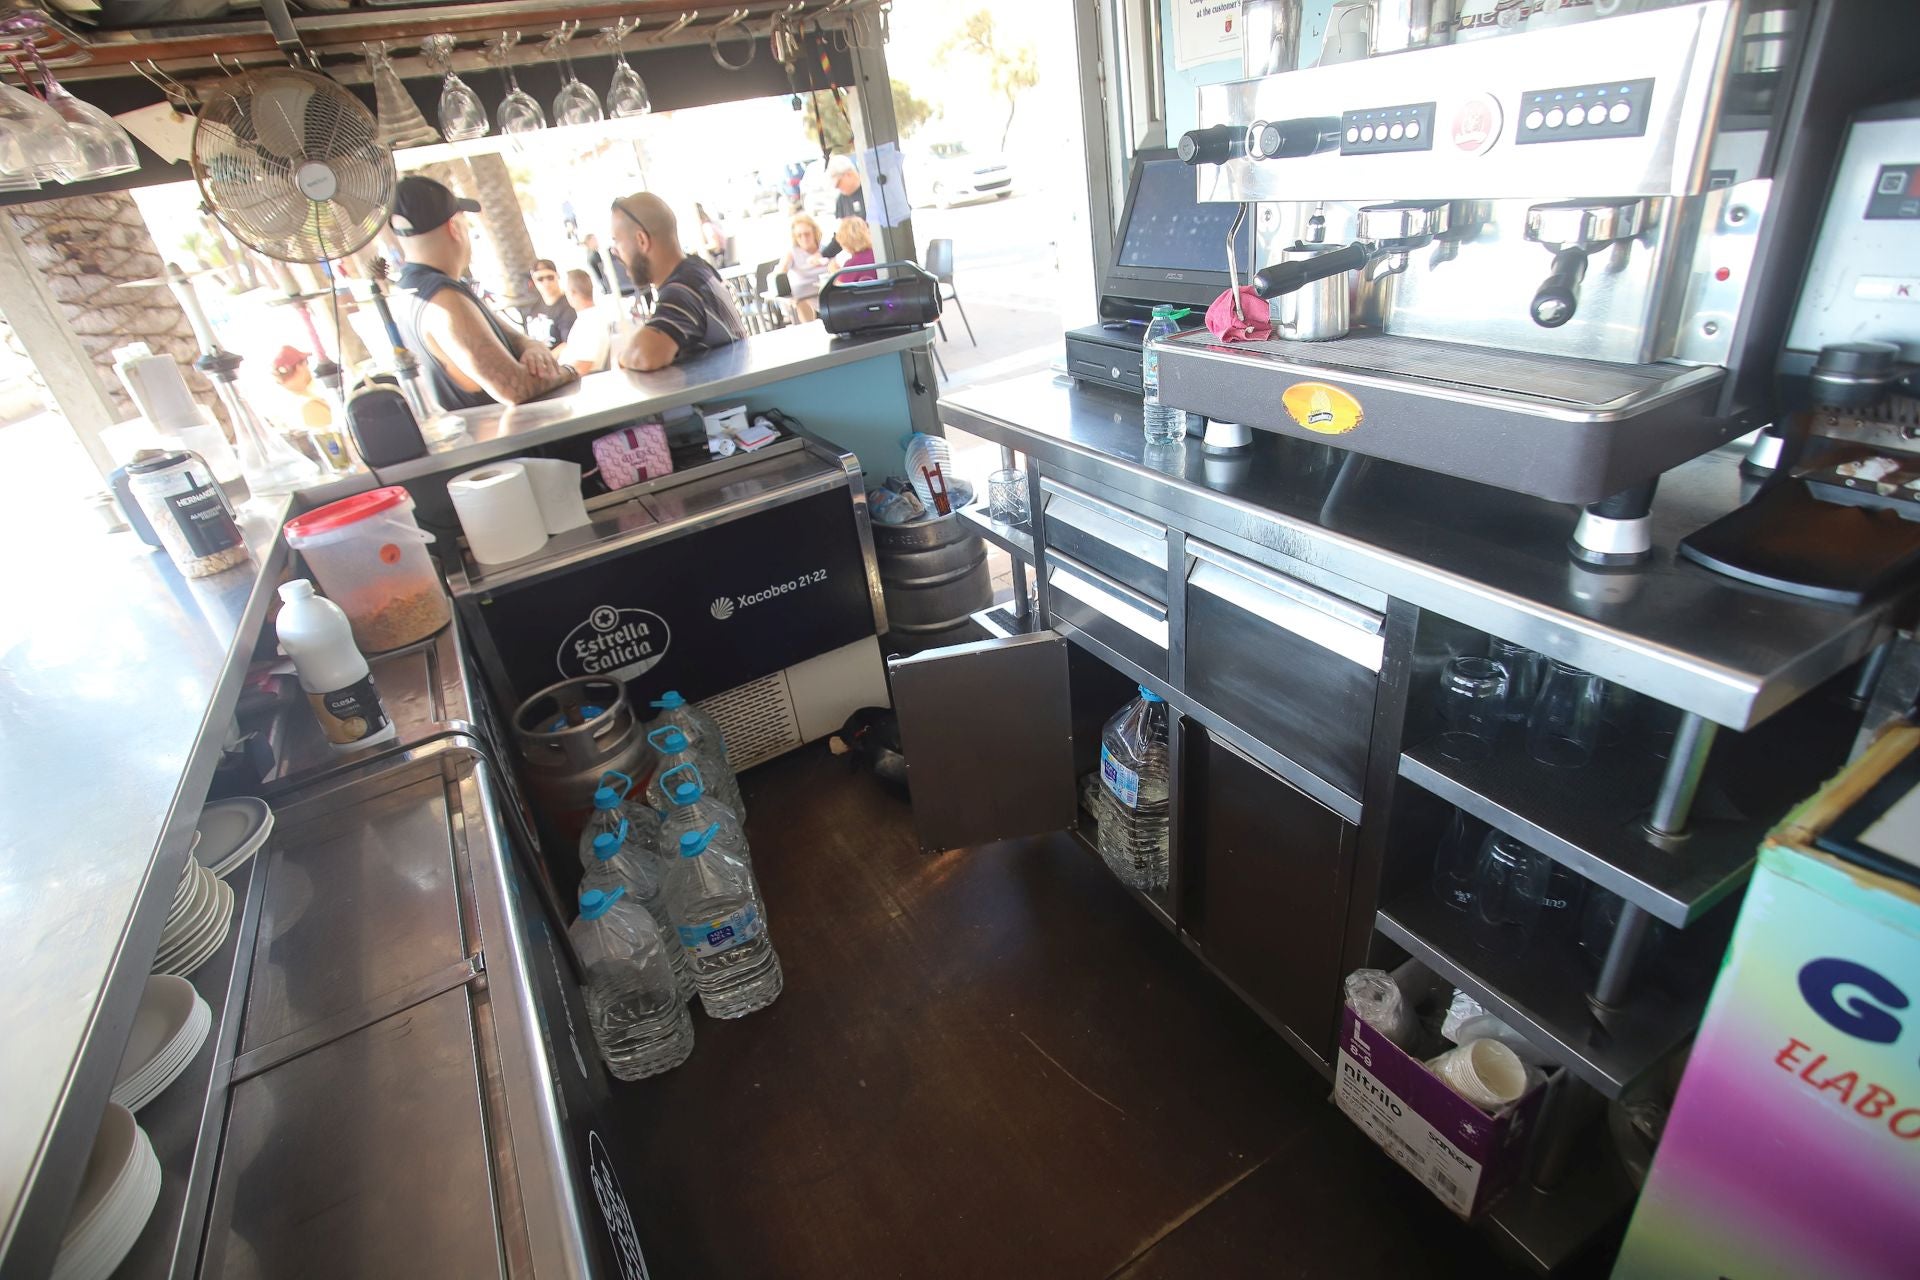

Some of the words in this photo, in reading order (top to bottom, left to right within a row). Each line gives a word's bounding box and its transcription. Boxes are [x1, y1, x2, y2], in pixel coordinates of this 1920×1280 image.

[1196, 9, 1202, 18] at
[1203, 6, 1211, 16] the
[1211, 0, 1241, 14] customer's
[737, 581, 797, 608] Xacobeo
[574, 622, 650, 659] Estrella
[583, 640, 652, 674] Galicia
[1353, 1018, 1371, 1051] L
[1344, 1062, 1402, 1117] nitrilo
